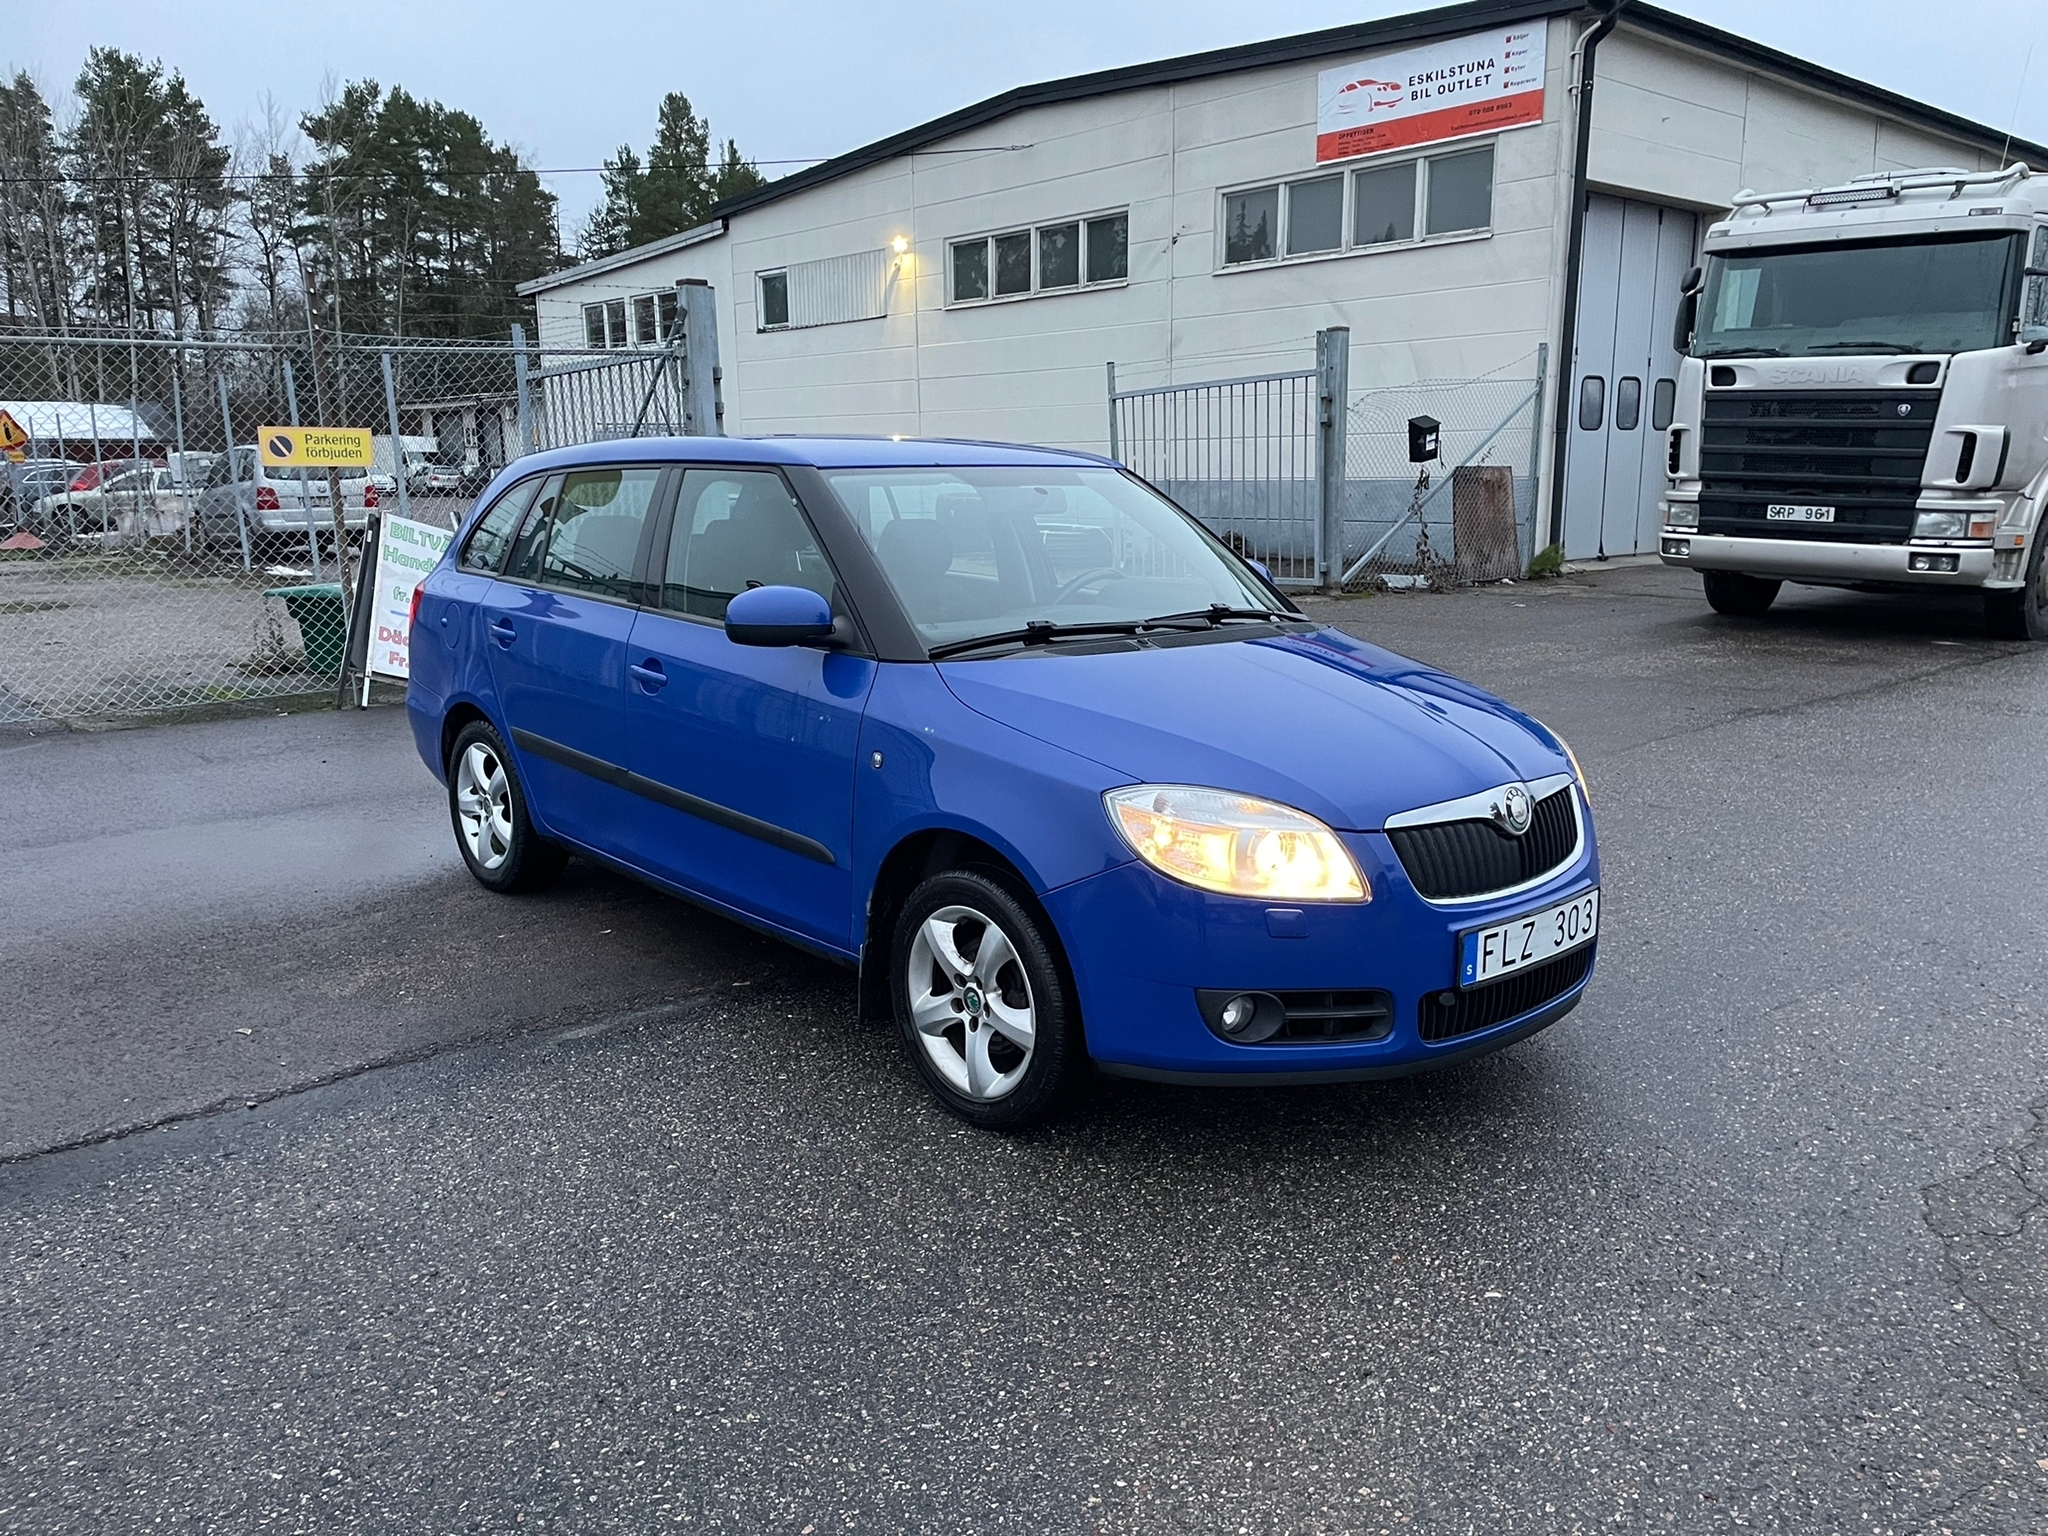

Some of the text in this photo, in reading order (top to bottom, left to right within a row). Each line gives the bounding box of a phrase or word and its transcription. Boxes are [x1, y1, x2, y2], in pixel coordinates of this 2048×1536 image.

[1408, 58, 1495, 87] ESKILSTUNA
[1411, 74, 1492, 101] BIL OUTLET
[1771, 365, 1865, 385] SCANIA
[304, 433, 361, 448] Parkering
[305, 446, 363, 460] förbjuden
[1769, 506, 1831, 520] SRP 961
[393, 586, 411, 603] fr.
[1466, 898, 1593, 976] S FLZ 303
